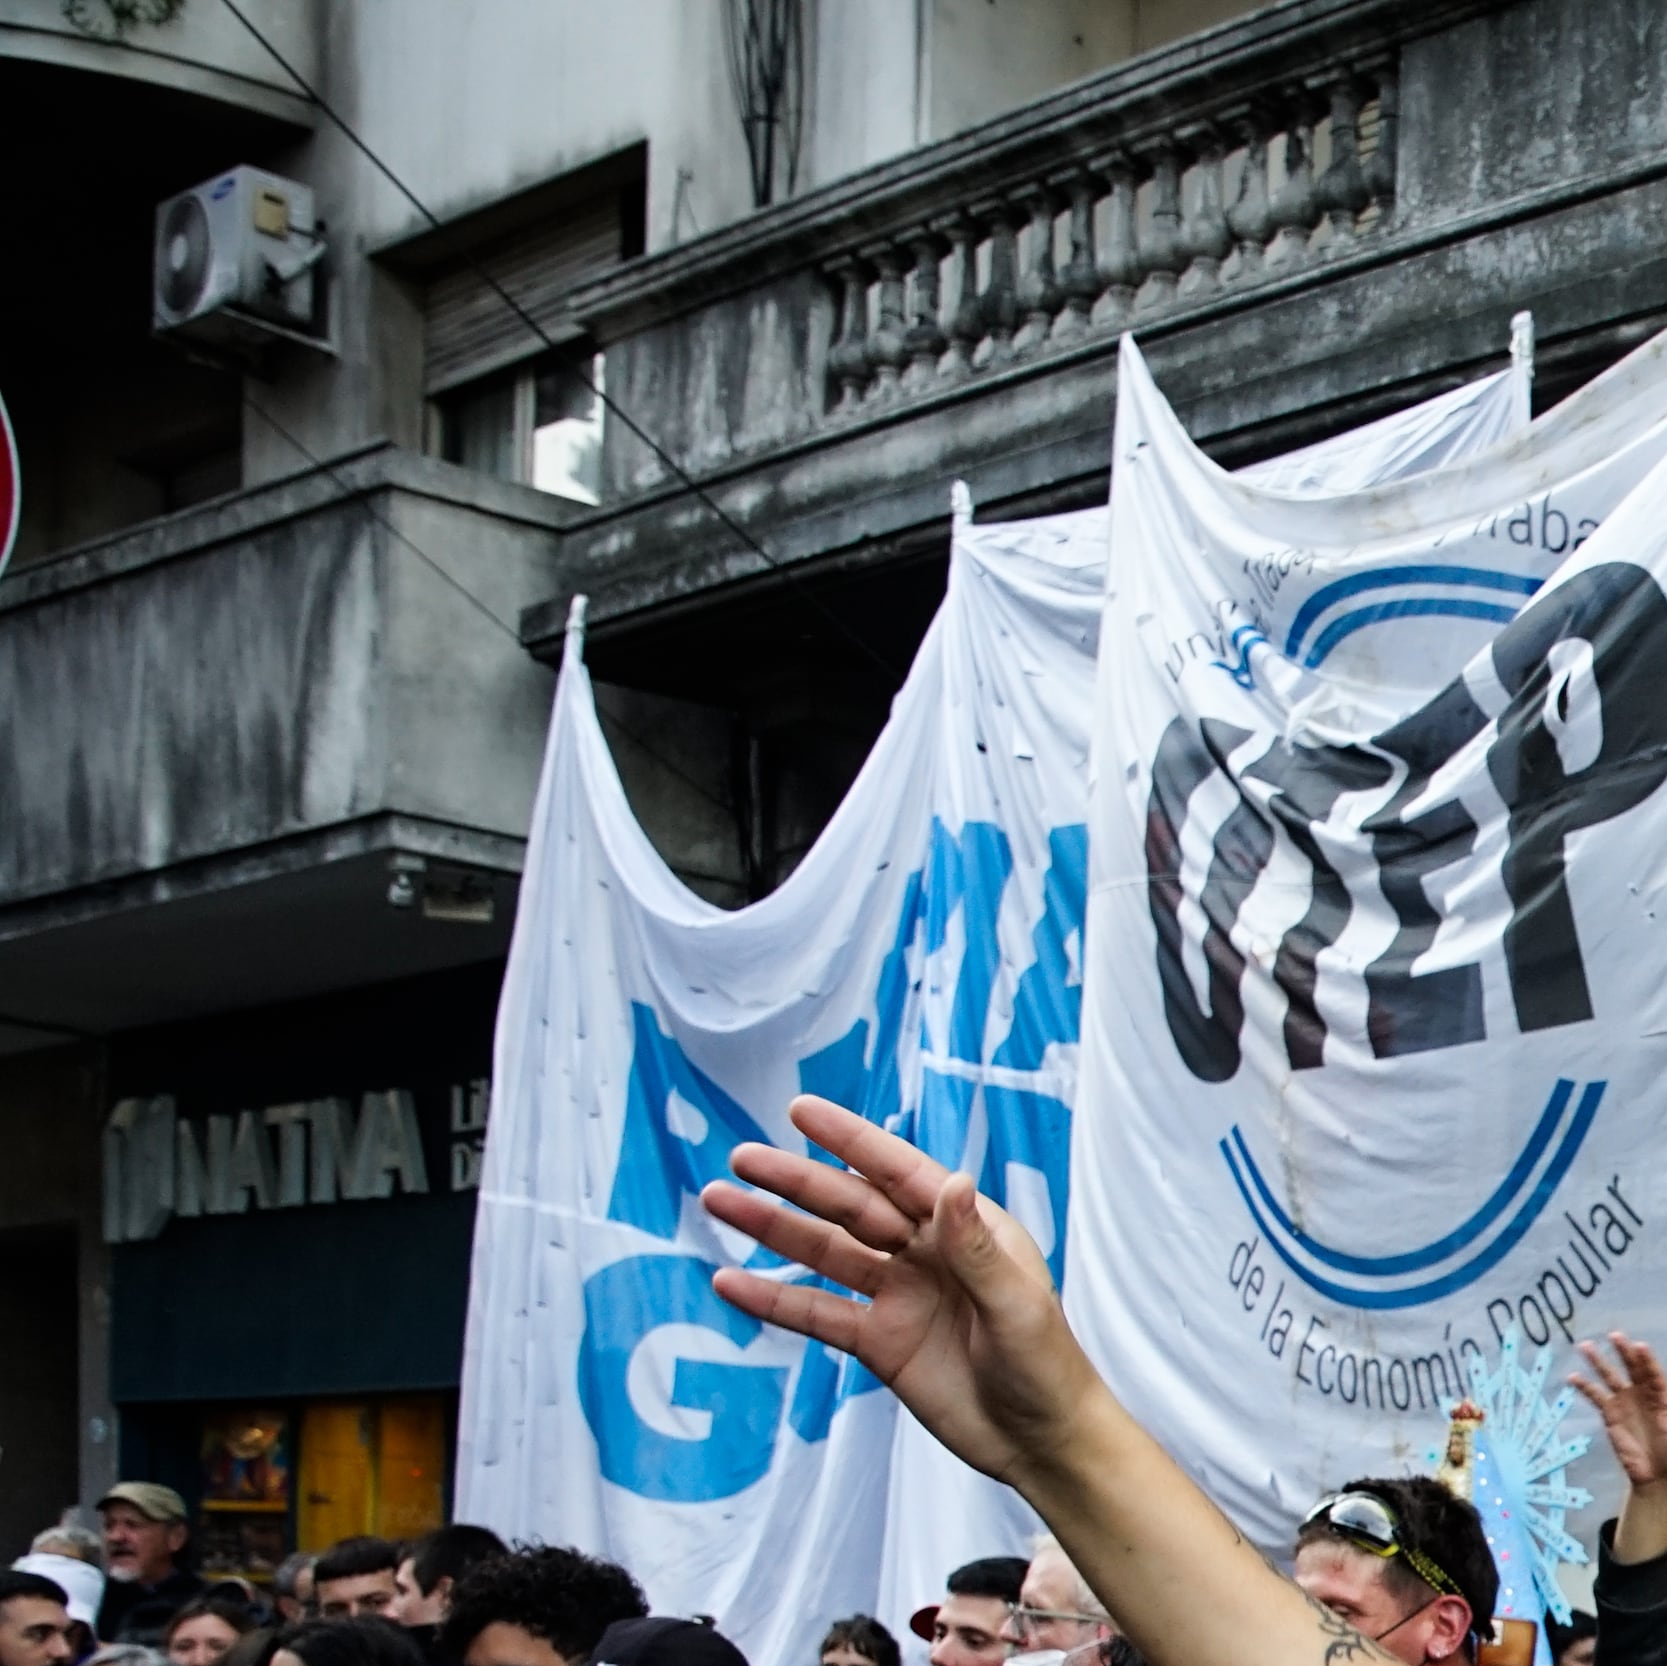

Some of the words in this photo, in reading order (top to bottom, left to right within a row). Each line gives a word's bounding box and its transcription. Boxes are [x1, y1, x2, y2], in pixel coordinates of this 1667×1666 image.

[1229, 1237, 1266, 1312] de
[1260, 1280, 1294, 1360] la
[1487, 1173, 1645, 1349] Popular
